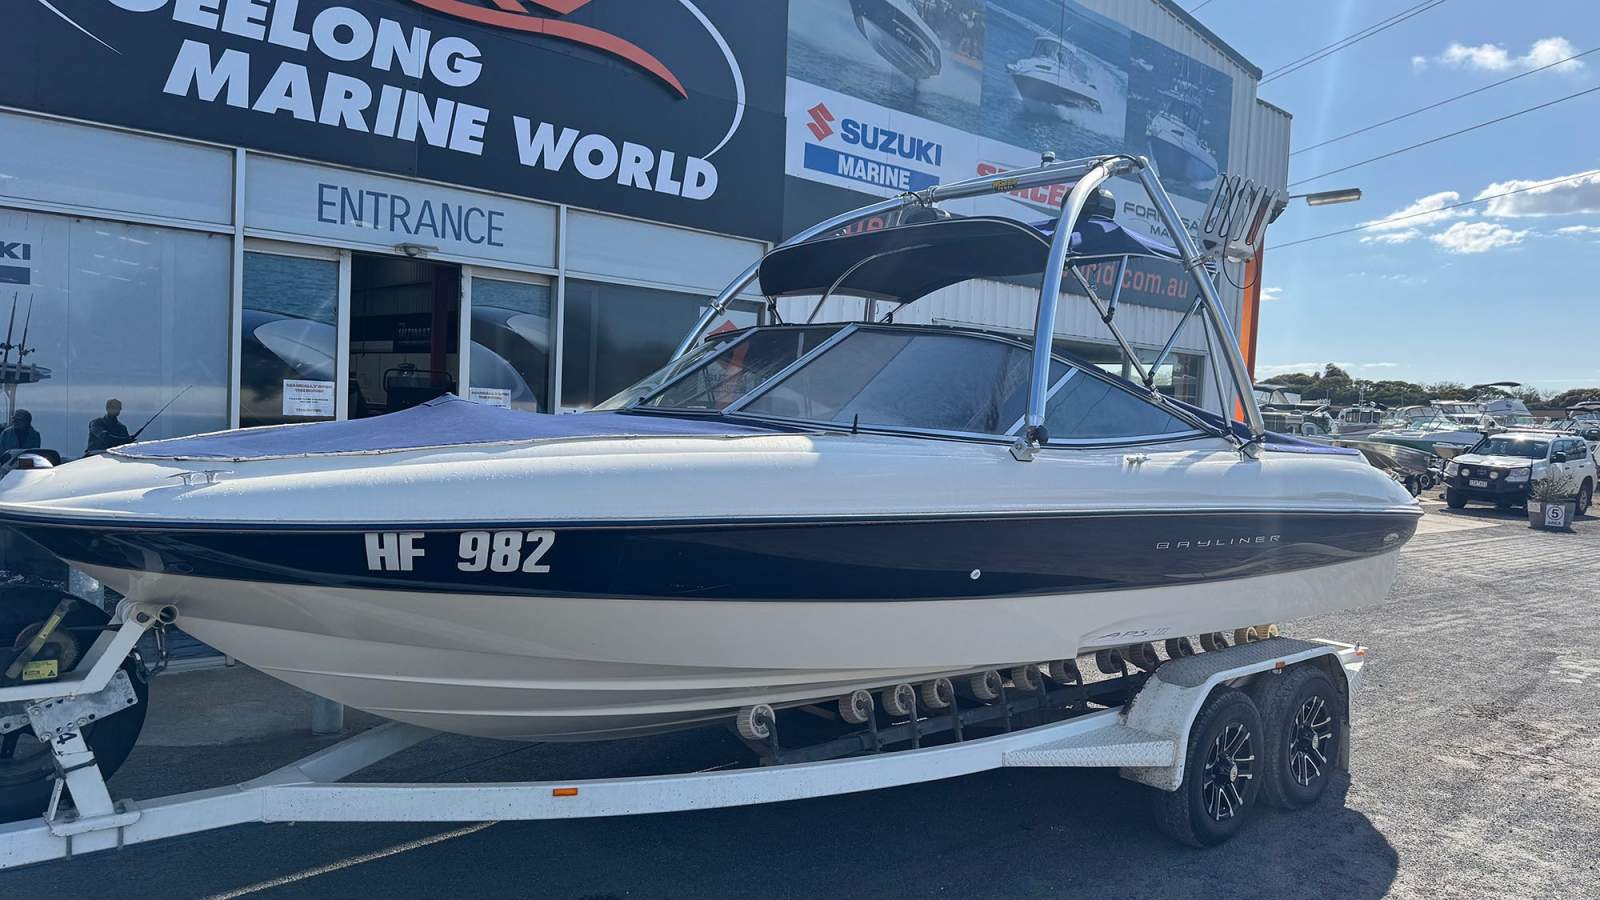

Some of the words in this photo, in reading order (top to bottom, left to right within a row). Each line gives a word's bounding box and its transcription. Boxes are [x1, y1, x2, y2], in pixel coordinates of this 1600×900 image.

[107, 0, 484, 87] EELONG
[163, 38, 490, 156] MARINE
[513, 115, 718, 201] WORLD
[840, 118, 942, 166] SUZUKI
[838, 154, 911, 190] MARINE
[317, 183, 505, 247] ENTRANCE
[1551, 508, 1560, 519] 5
[364, 532, 425, 571] HF
[457, 529, 556, 573] 982
[1156, 535, 1281, 549] BAYLINER
